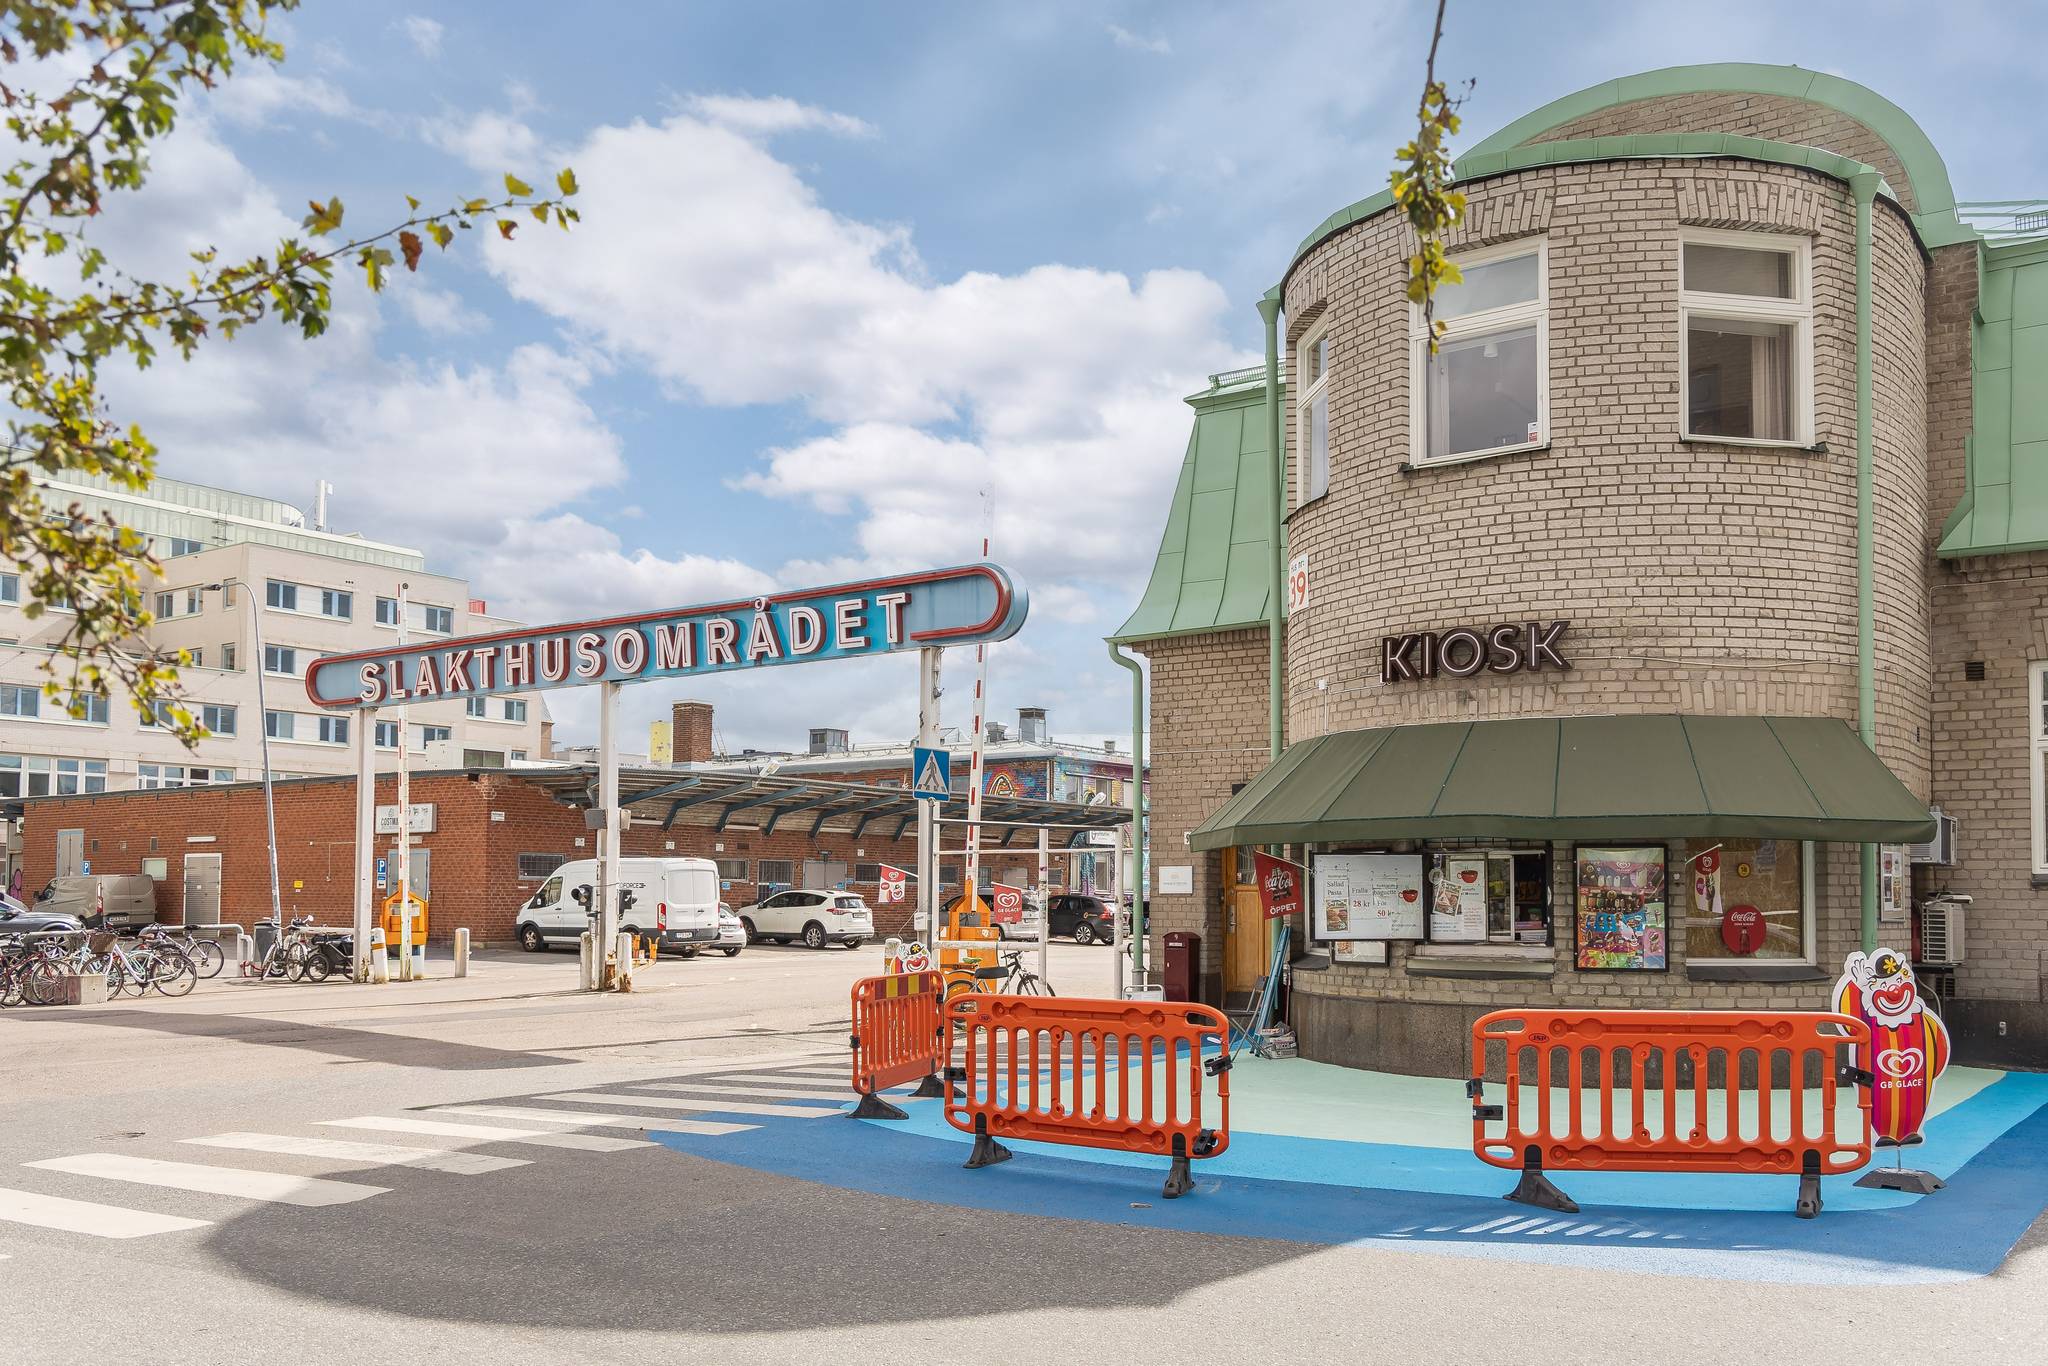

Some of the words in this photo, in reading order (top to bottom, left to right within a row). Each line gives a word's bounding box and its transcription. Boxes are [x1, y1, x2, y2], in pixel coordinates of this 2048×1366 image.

[1290, 571, 1306, 608] 39
[360, 592, 910, 703] SLAKTHUSOMRÅDET
[1382, 621, 1572, 682] KIOSK
[84, 862, 89, 872] P
[379, 860, 385, 873] P
[1269, 902, 1297, 915] ÖPPET
[1353, 900, 1362, 908] 28
[1363, 900, 1370, 908] kr
[1377, 909, 1387, 917] 50
[1731, 911, 1757, 922] Coca-Cola
[1880, 1081, 1893, 1089] GB
[1896, 1079, 1923, 1088] GLACE
